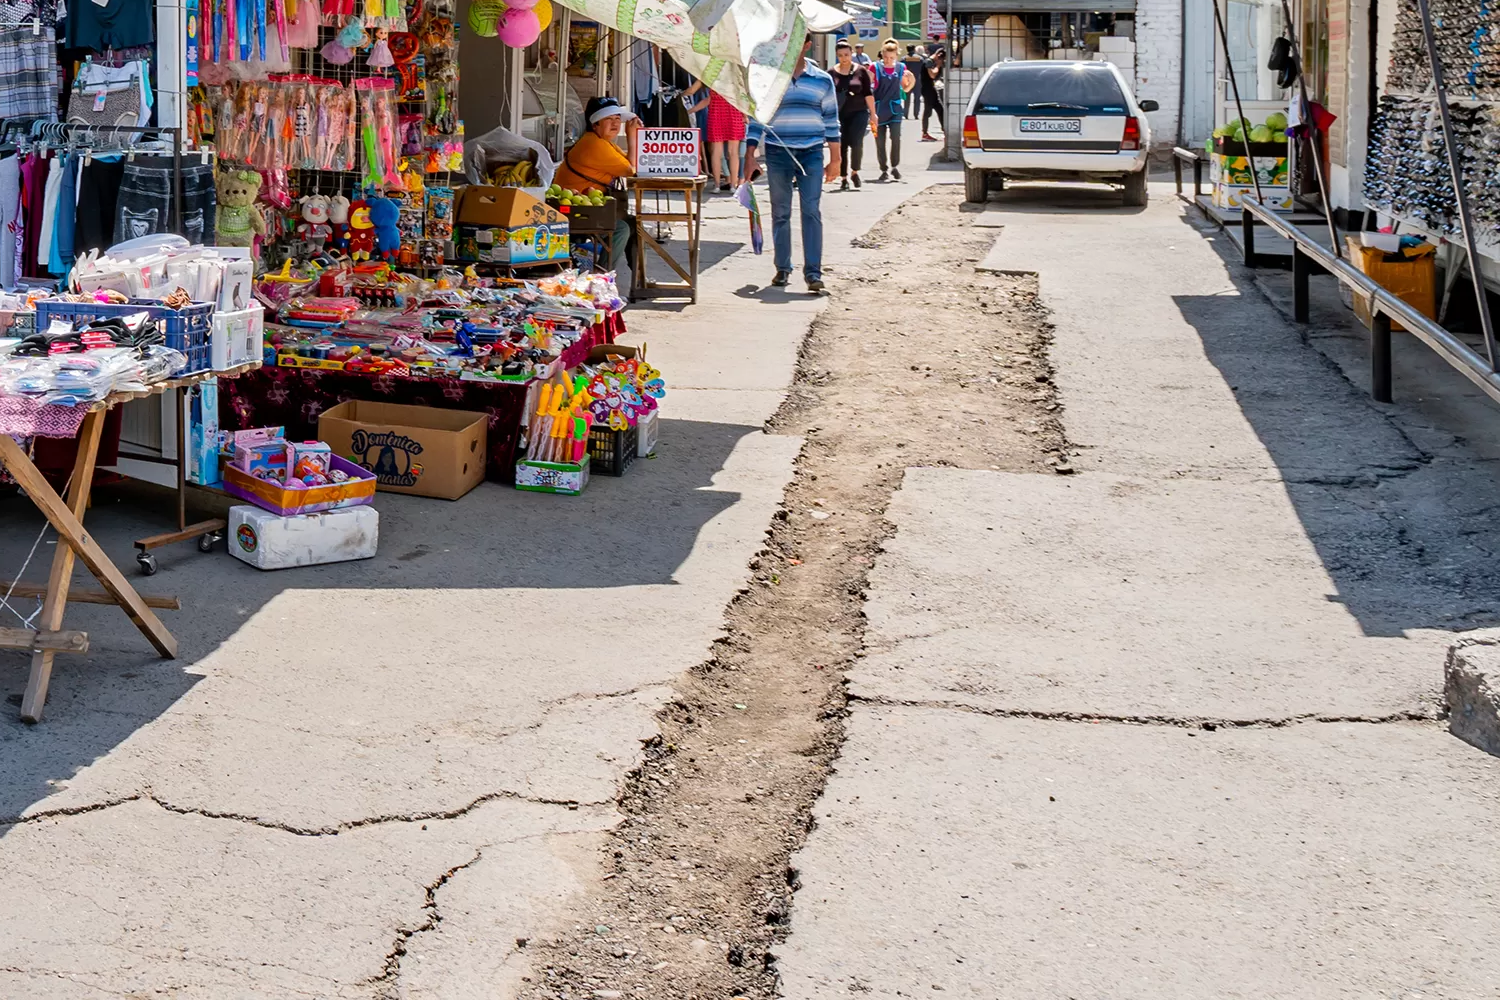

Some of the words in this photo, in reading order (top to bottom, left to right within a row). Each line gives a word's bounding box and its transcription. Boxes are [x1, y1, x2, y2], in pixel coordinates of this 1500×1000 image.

[645, 130, 693, 141] КУПЛЮ
[642, 142, 695, 154] ЗОЛОТО
[639, 154, 698, 166] СЕРЕБРО
